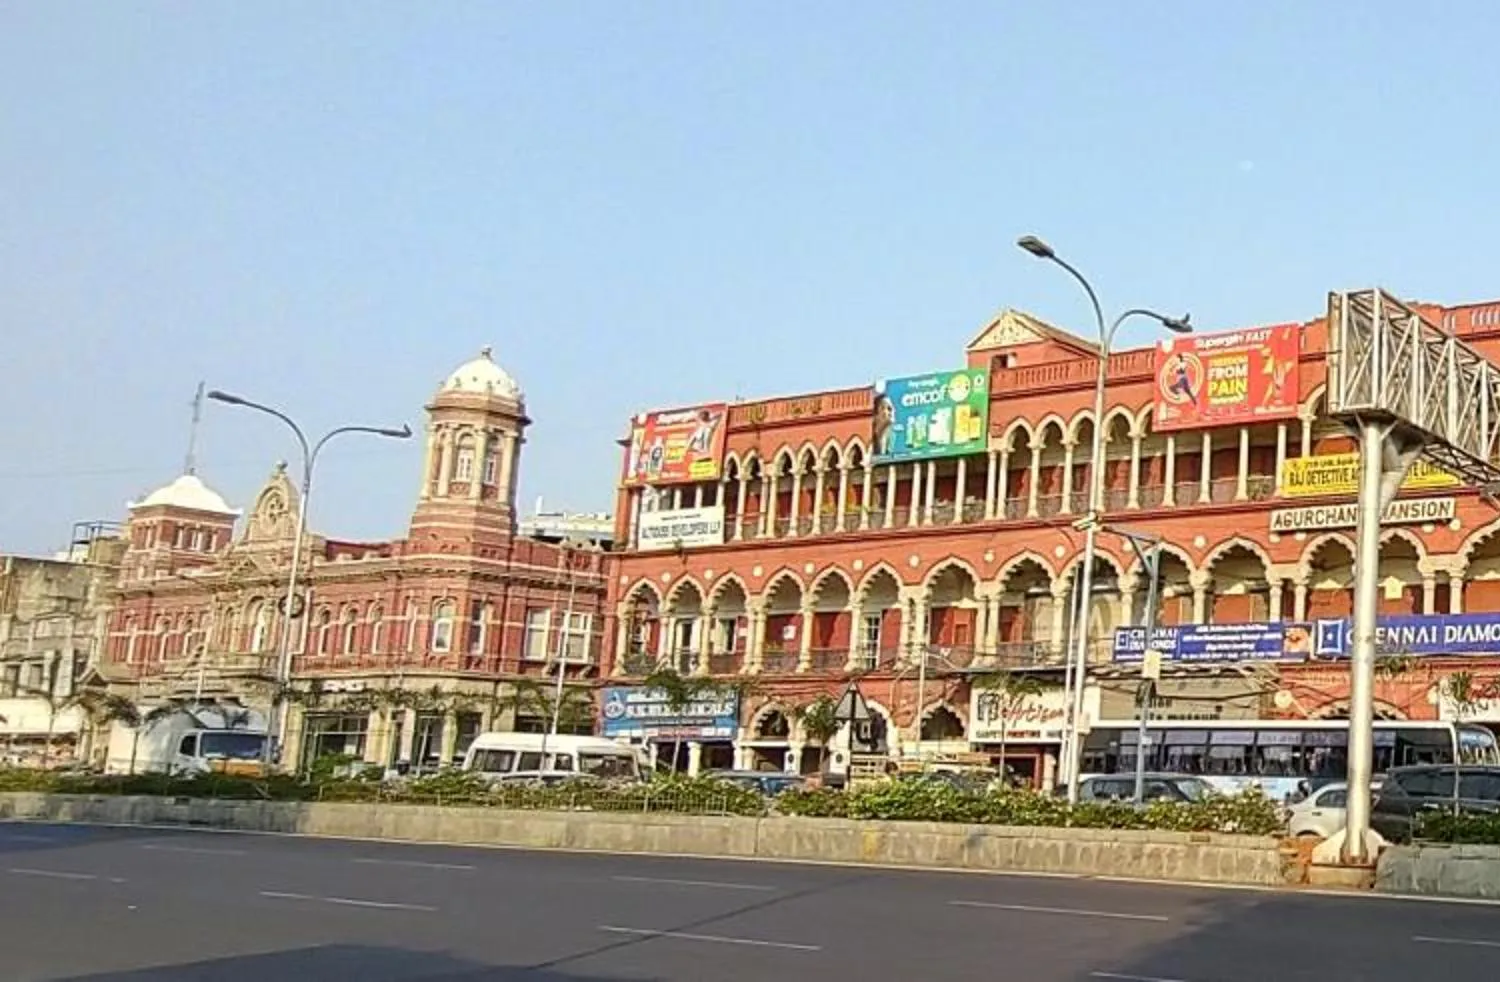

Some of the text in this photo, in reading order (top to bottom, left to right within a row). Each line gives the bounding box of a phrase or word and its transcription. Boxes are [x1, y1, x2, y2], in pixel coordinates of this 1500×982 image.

[1208, 365, 1248, 379] FROM
[1208, 380, 1248, 396] PAIN
[1289, 472, 1305, 486] RAJ
[1307, 466, 1350, 485] DETECTIVE
[1273, 501, 1451, 529] AGURCHAN ANSION
[1131, 628, 1177, 638] CHNNAI
[1346, 624, 1437, 644] CENNAI
[1130, 640, 1177, 650] DIAONDS
